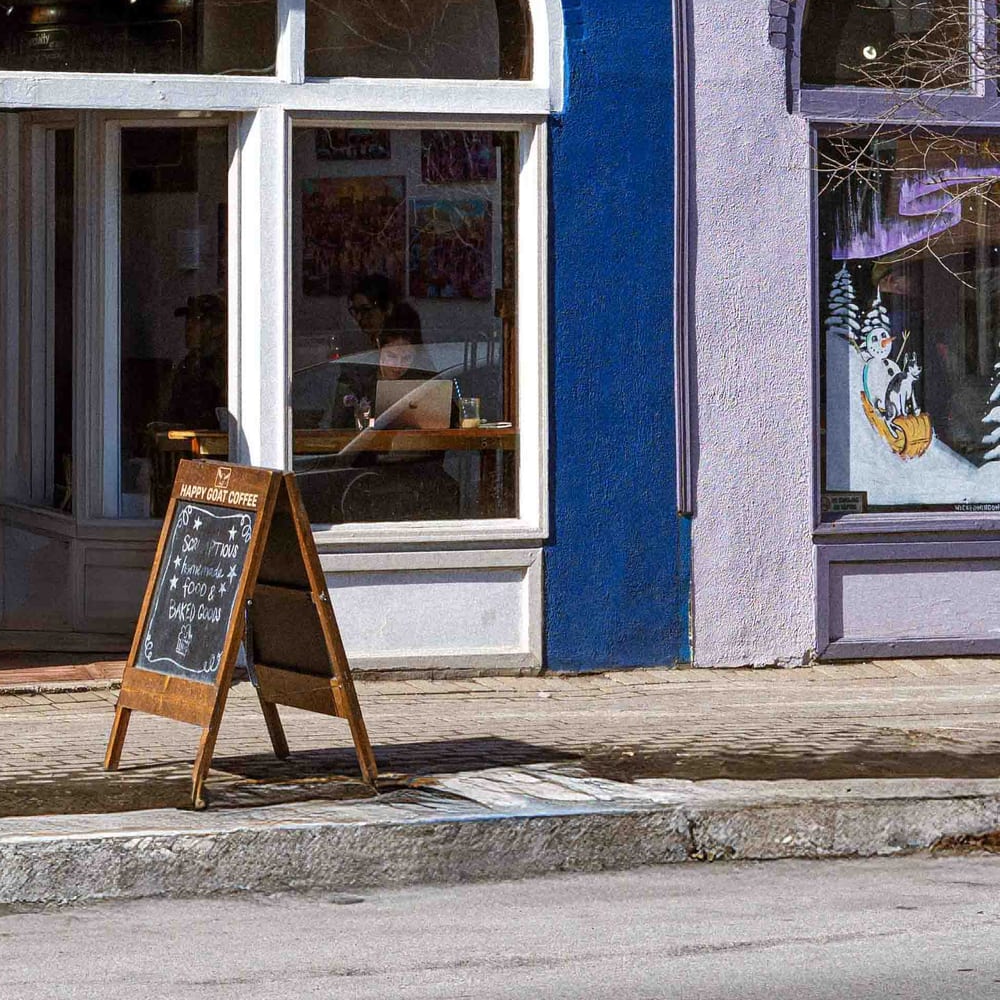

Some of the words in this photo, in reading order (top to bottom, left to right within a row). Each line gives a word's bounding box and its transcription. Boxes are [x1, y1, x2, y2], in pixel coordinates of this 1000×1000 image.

[180, 483, 207, 499] HAPPY
[206, 488, 229, 503] GOAT
[228, 490, 259, 507] COFFEE
[180, 555, 225, 578] homemade
[207, 585, 216, 602] &
[169, 598, 196, 623] BAKED
